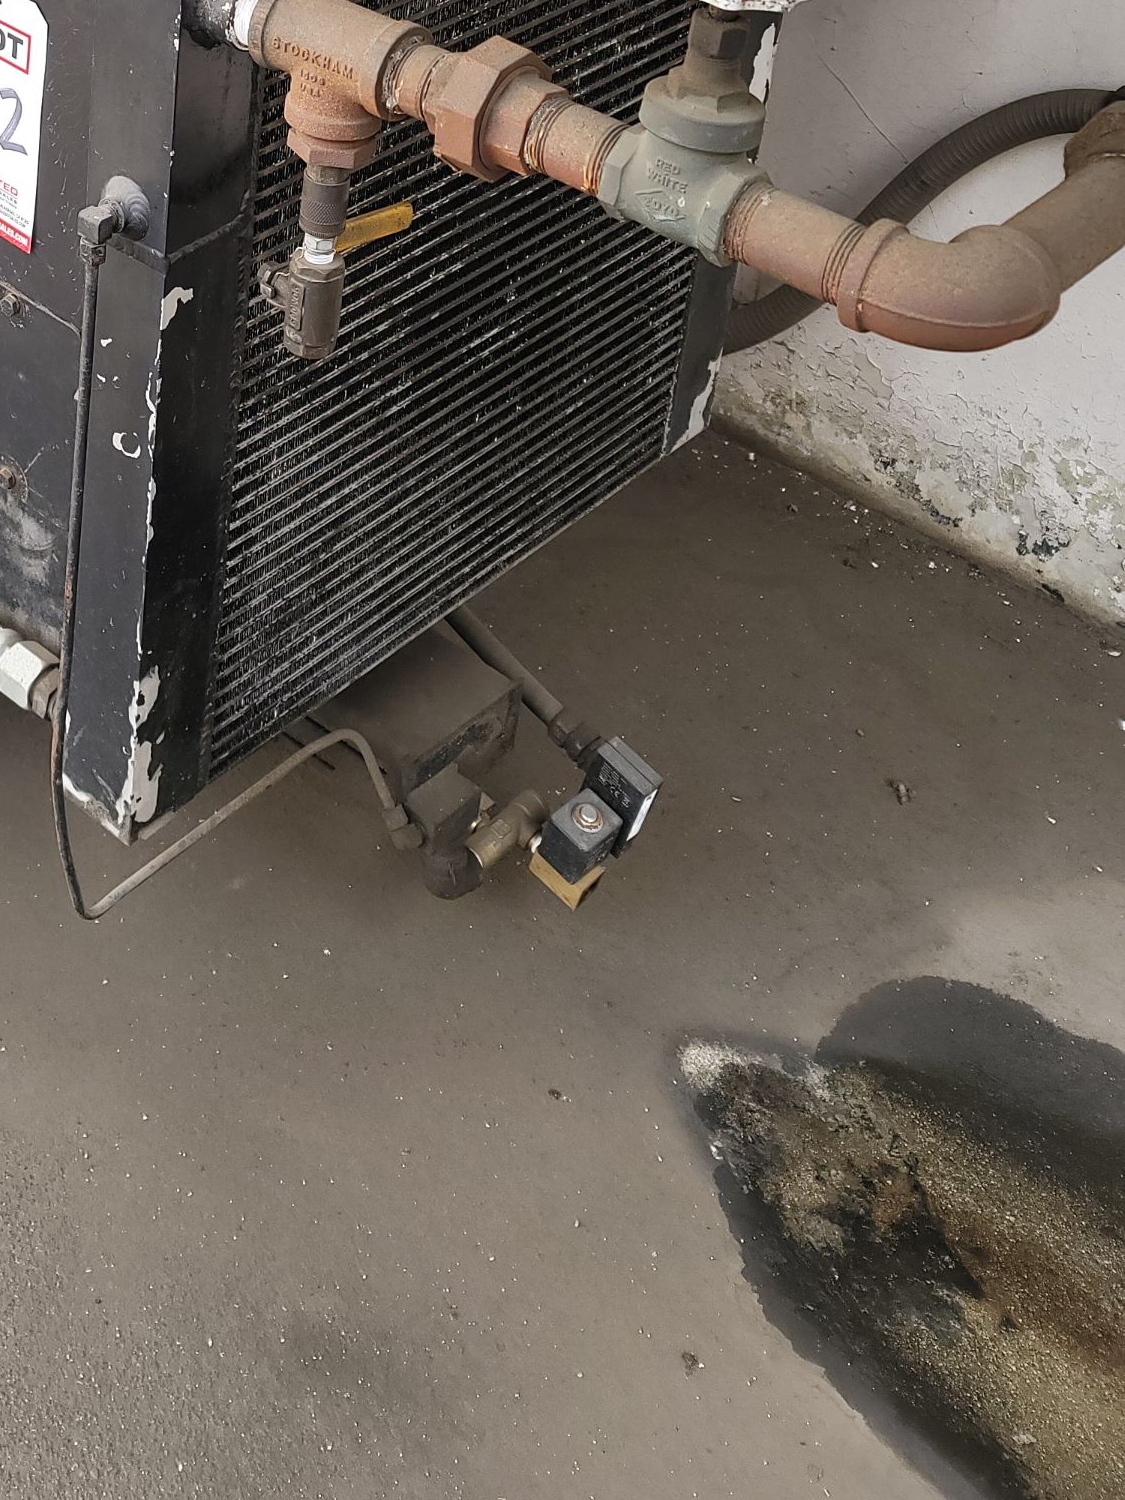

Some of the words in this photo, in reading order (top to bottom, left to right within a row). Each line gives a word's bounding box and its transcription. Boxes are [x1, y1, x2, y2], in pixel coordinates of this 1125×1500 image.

[271, 35, 354, 80] STOCKHAM
[655, 157, 682, 176] RED
[647, 168, 689, 194] WHITE
